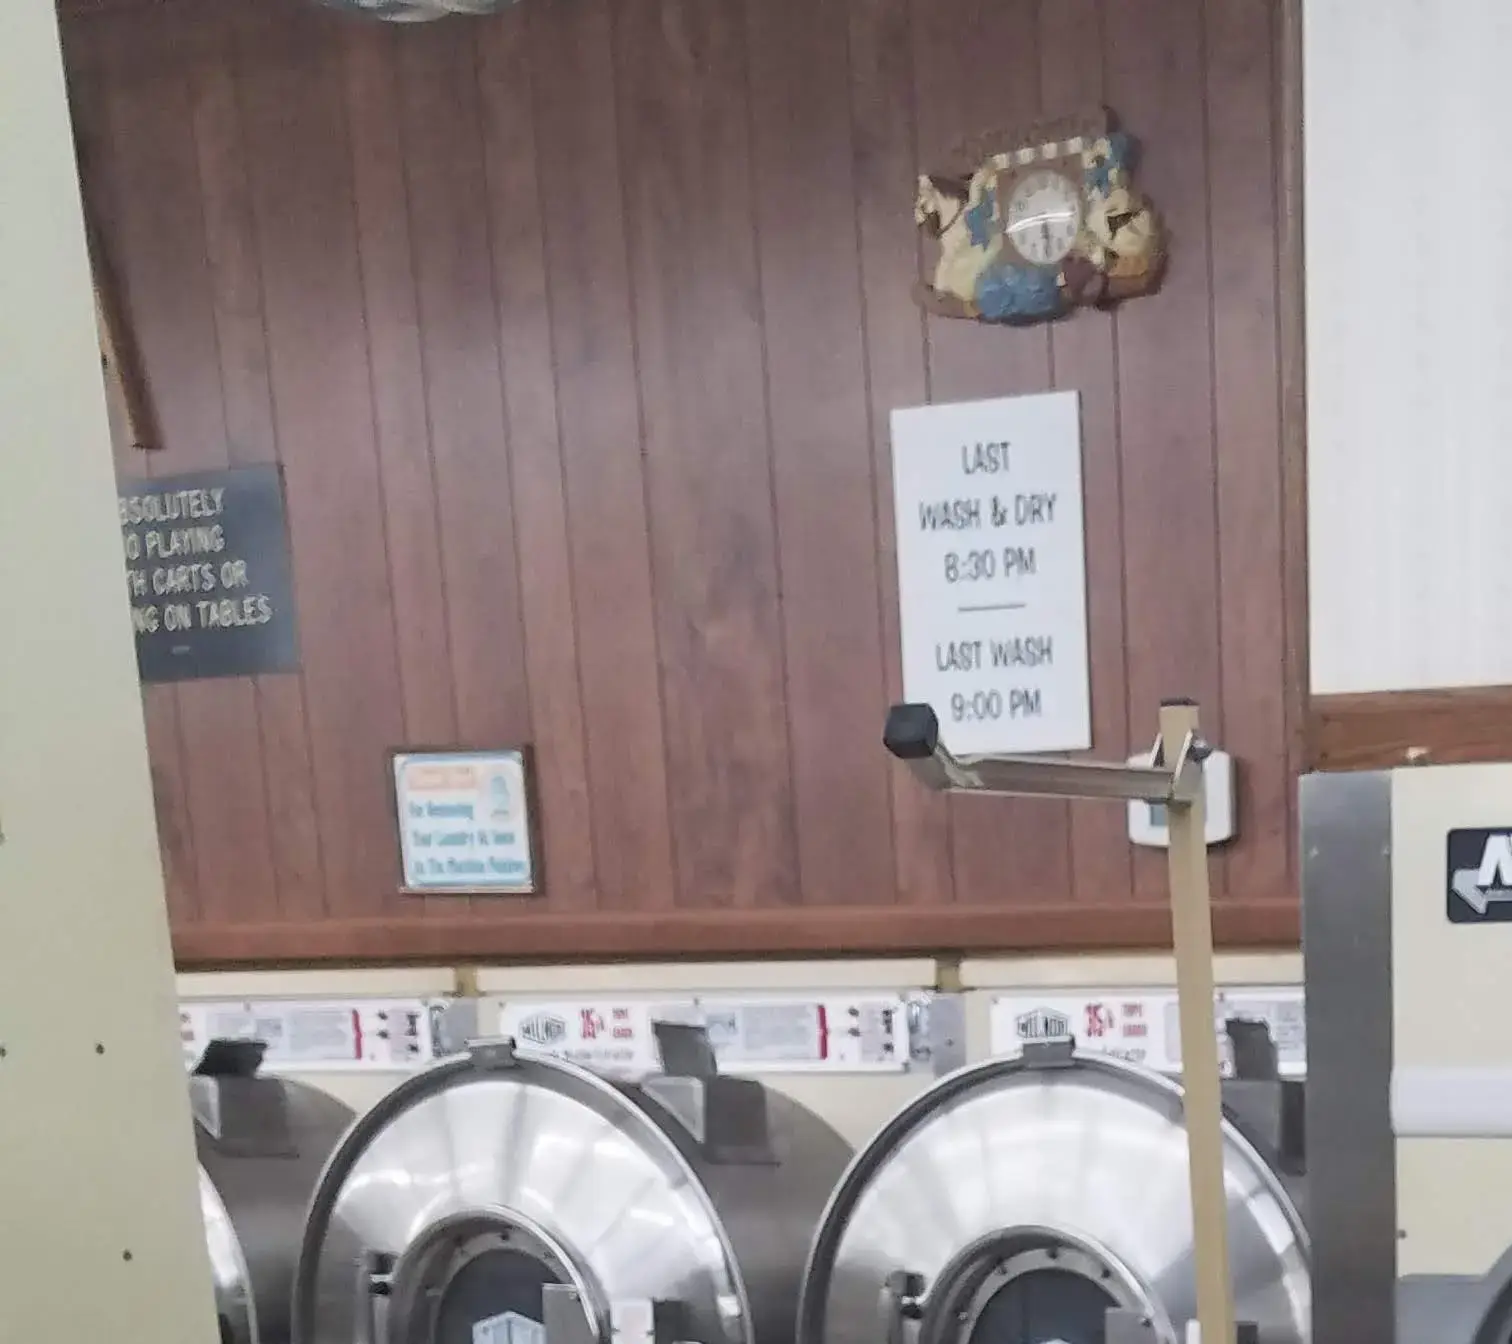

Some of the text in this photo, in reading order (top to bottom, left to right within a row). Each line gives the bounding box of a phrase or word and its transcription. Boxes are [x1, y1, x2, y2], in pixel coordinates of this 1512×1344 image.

[961, 441, 1011, 475] LAST
[118, 488, 226, 525] BSOLUTELY
[919, 493, 1057, 532] WASH & DRY
[126, 525, 226, 560] O PLAYING
[153, 563, 216, 595] CARTS
[221, 560, 249, 589] OR
[944, 547, 1036, 585] 8:30 PM
[164, 604, 192, 631] ON
[196, 594, 272, 628] TABLES
[935, 636, 1053, 673] LAST WASH
[951, 689, 1042, 722] 9:00 PM
